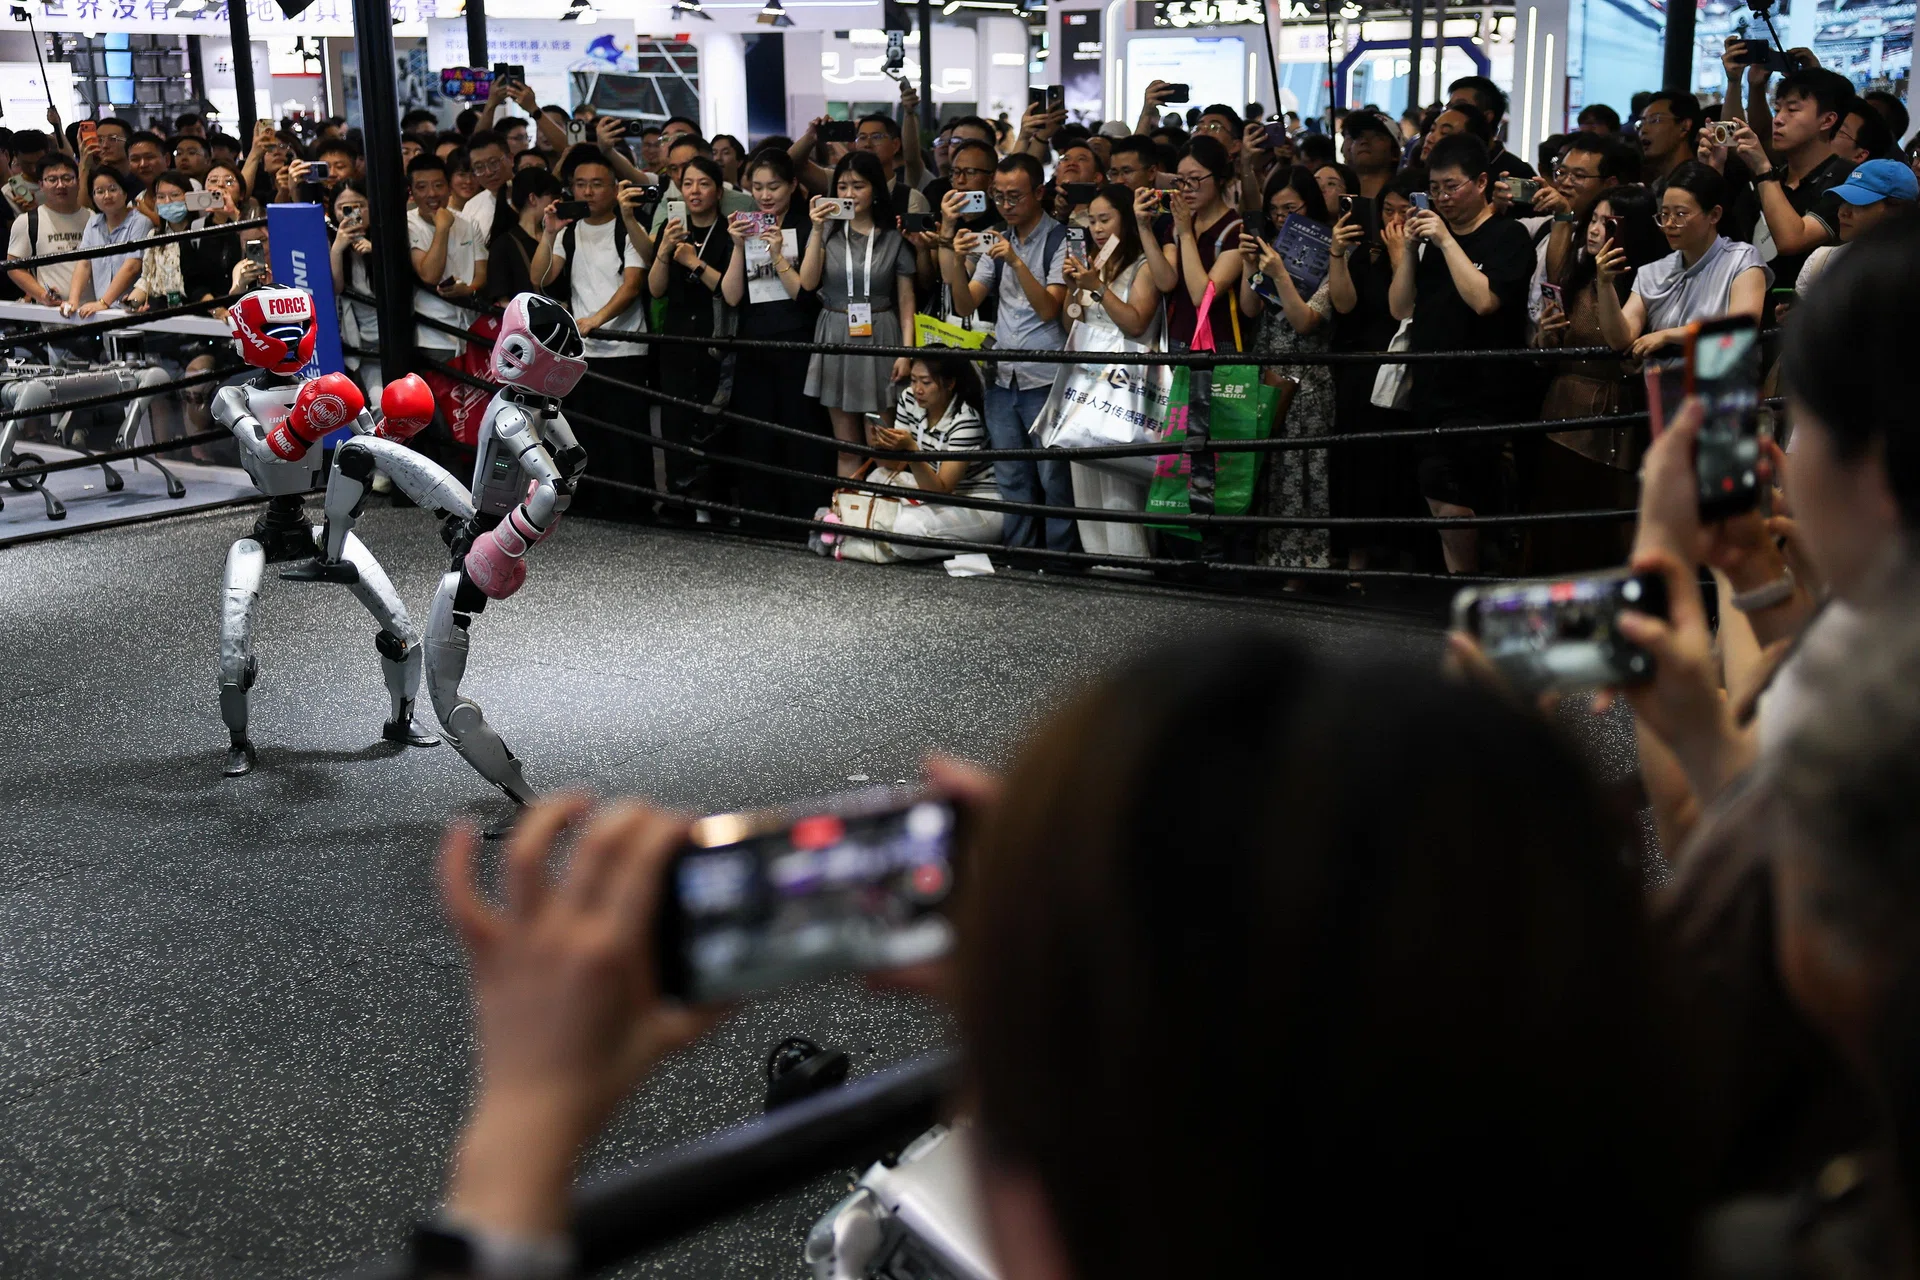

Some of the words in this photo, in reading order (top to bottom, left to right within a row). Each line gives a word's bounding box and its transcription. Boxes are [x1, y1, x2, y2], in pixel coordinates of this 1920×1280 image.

[268, 297, 307, 315] FORCE
[234, 303, 270, 352] BOOM!
[273, 428, 295, 454] FORCE
